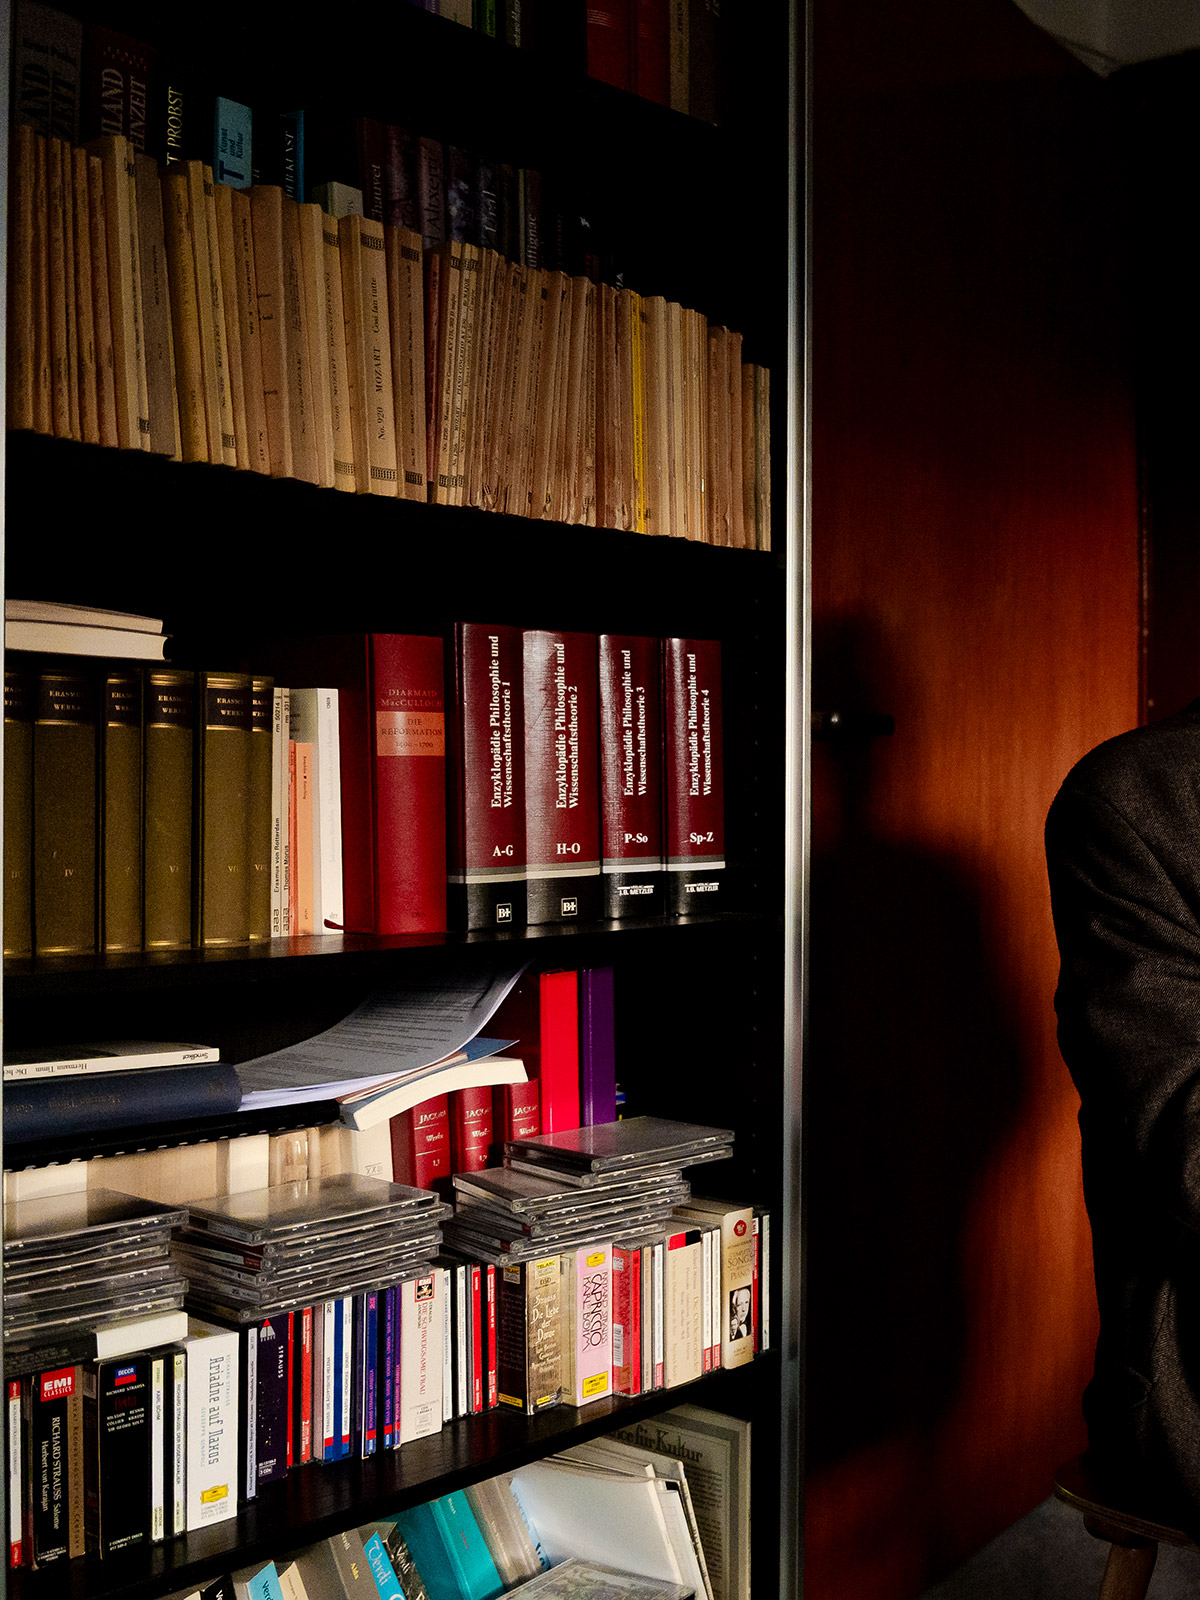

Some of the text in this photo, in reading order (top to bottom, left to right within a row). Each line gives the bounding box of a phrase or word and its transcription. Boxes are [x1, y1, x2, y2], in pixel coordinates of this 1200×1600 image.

[219, 128, 228, 155] Kunst
[228, 139, 236, 156] und
[235, 131, 243, 159] Kultur
[219, 160, 244, 180] T
[371, 163, 383, 220] Chauvet
[370, 278, 378, 298] tutte
[370, 300, 379, 313] fan
[330, 358, 339, 395] MOZART
[373, 346, 383, 392] MOZART
[376, 407, 385, 424] 920
[377, 425, 385, 440] No.
[388, 689, 438, 697] DIARMAID
[380, 699, 442, 708] MacCULLOCH
[273, 702, 281, 733] rm 50214
[408, 718, 422, 726] DIE
[488, 636, 503, 807] Enzyklopädie Philosophie und
[554, 643, 568, 808] Enzyklopädie Philosophie und
[621, 650, 636, 795] Enzyklopädie Philosophie und
[686, 654, 700, 795] Enzyklopädie Philosophie und
[381, 728, 443, 736] REFORMATION
[701, 689, 712, 795] Wissenschaftstheorie 4
[502, 691, 513, 807] Wissenschaftstheorie
[569, 695, 579, 808] Wissenschaftstheorie
[637, 695, 647, 795] Wissenschaftstheorie
[624, 833, 649, 844] P-So
[690, 831, 714, 845] Sp-Z
[493, 844, 514, 857] A-G
[556, 842, 581, 855] H-O
[15, 1068, 27, 1076] Die
[35, 1065, 55, 1074] Timm
[56, 1062, 87, 1073] Hermann
[536, 1260, 555, 1269] TELARC
[727, 1254, 753, 1269] SONGS
[730, 1270, 750, 1281] PIANO
[531, 1305, 560, 1325] Die Liebe
[590, 1274, 603, 1347] CAPRICCIO
[542, 1319, 552, 1329] der
[117, 1368, 135, 1376] DECCA
[43, 1376, 72, 1391] EMI
[43, 1386, 73, 1399] CLASSICS
[106, 1383, 145, 1396] RICHARD STRAUSS
[208, 1356, 224, 1464] Ariadne auf Naxos
[635, 1425, 703, 1462] für Kultur
[41, 1440, 50, 1468] Herbert
[52, 1416, 62, 1529] RICHARD STRAUSS Salome
[41, 1484, 50, 1512] Karajan
[368, 1539, 392, 1587] Verdi
[394, 1546, 410, 1575] Verdi
[350, 1562, 359, 1580] Aida
